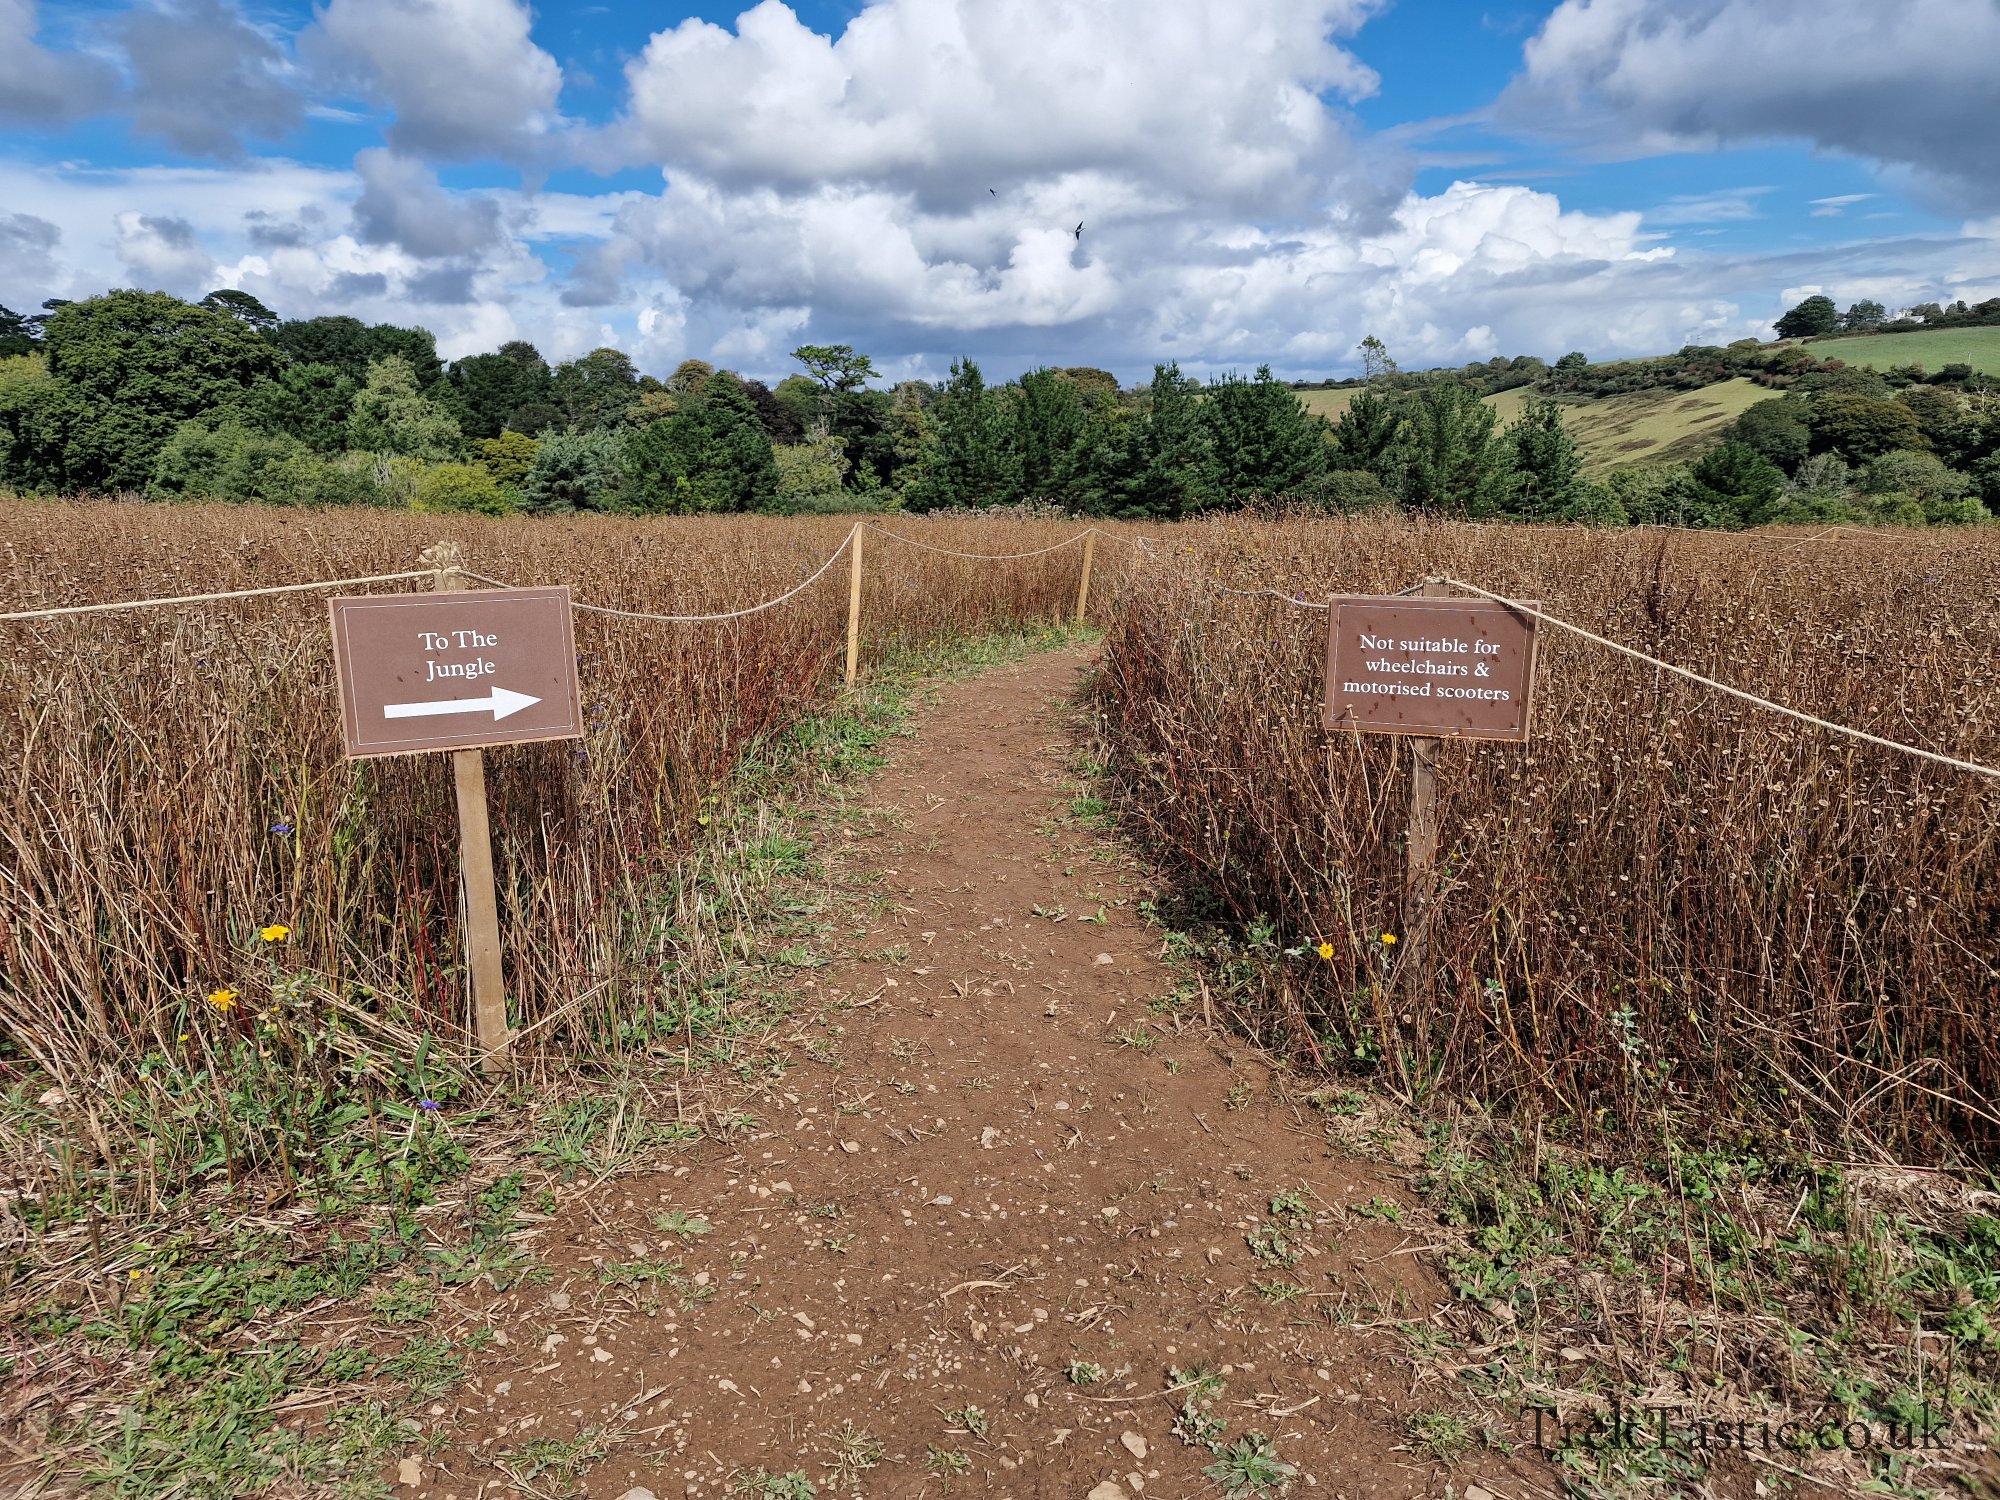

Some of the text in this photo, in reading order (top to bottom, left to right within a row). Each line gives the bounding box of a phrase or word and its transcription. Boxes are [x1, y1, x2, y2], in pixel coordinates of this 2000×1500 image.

[418, 630, 498, 650] To The
[1360, 634, 1501, 655] Not suitable for
[426, 658, 496, 682] Jungle
[1366, 658, 1490, 677] wheelchairs &
[1343, 680, 1510, 701] motorised scooters
